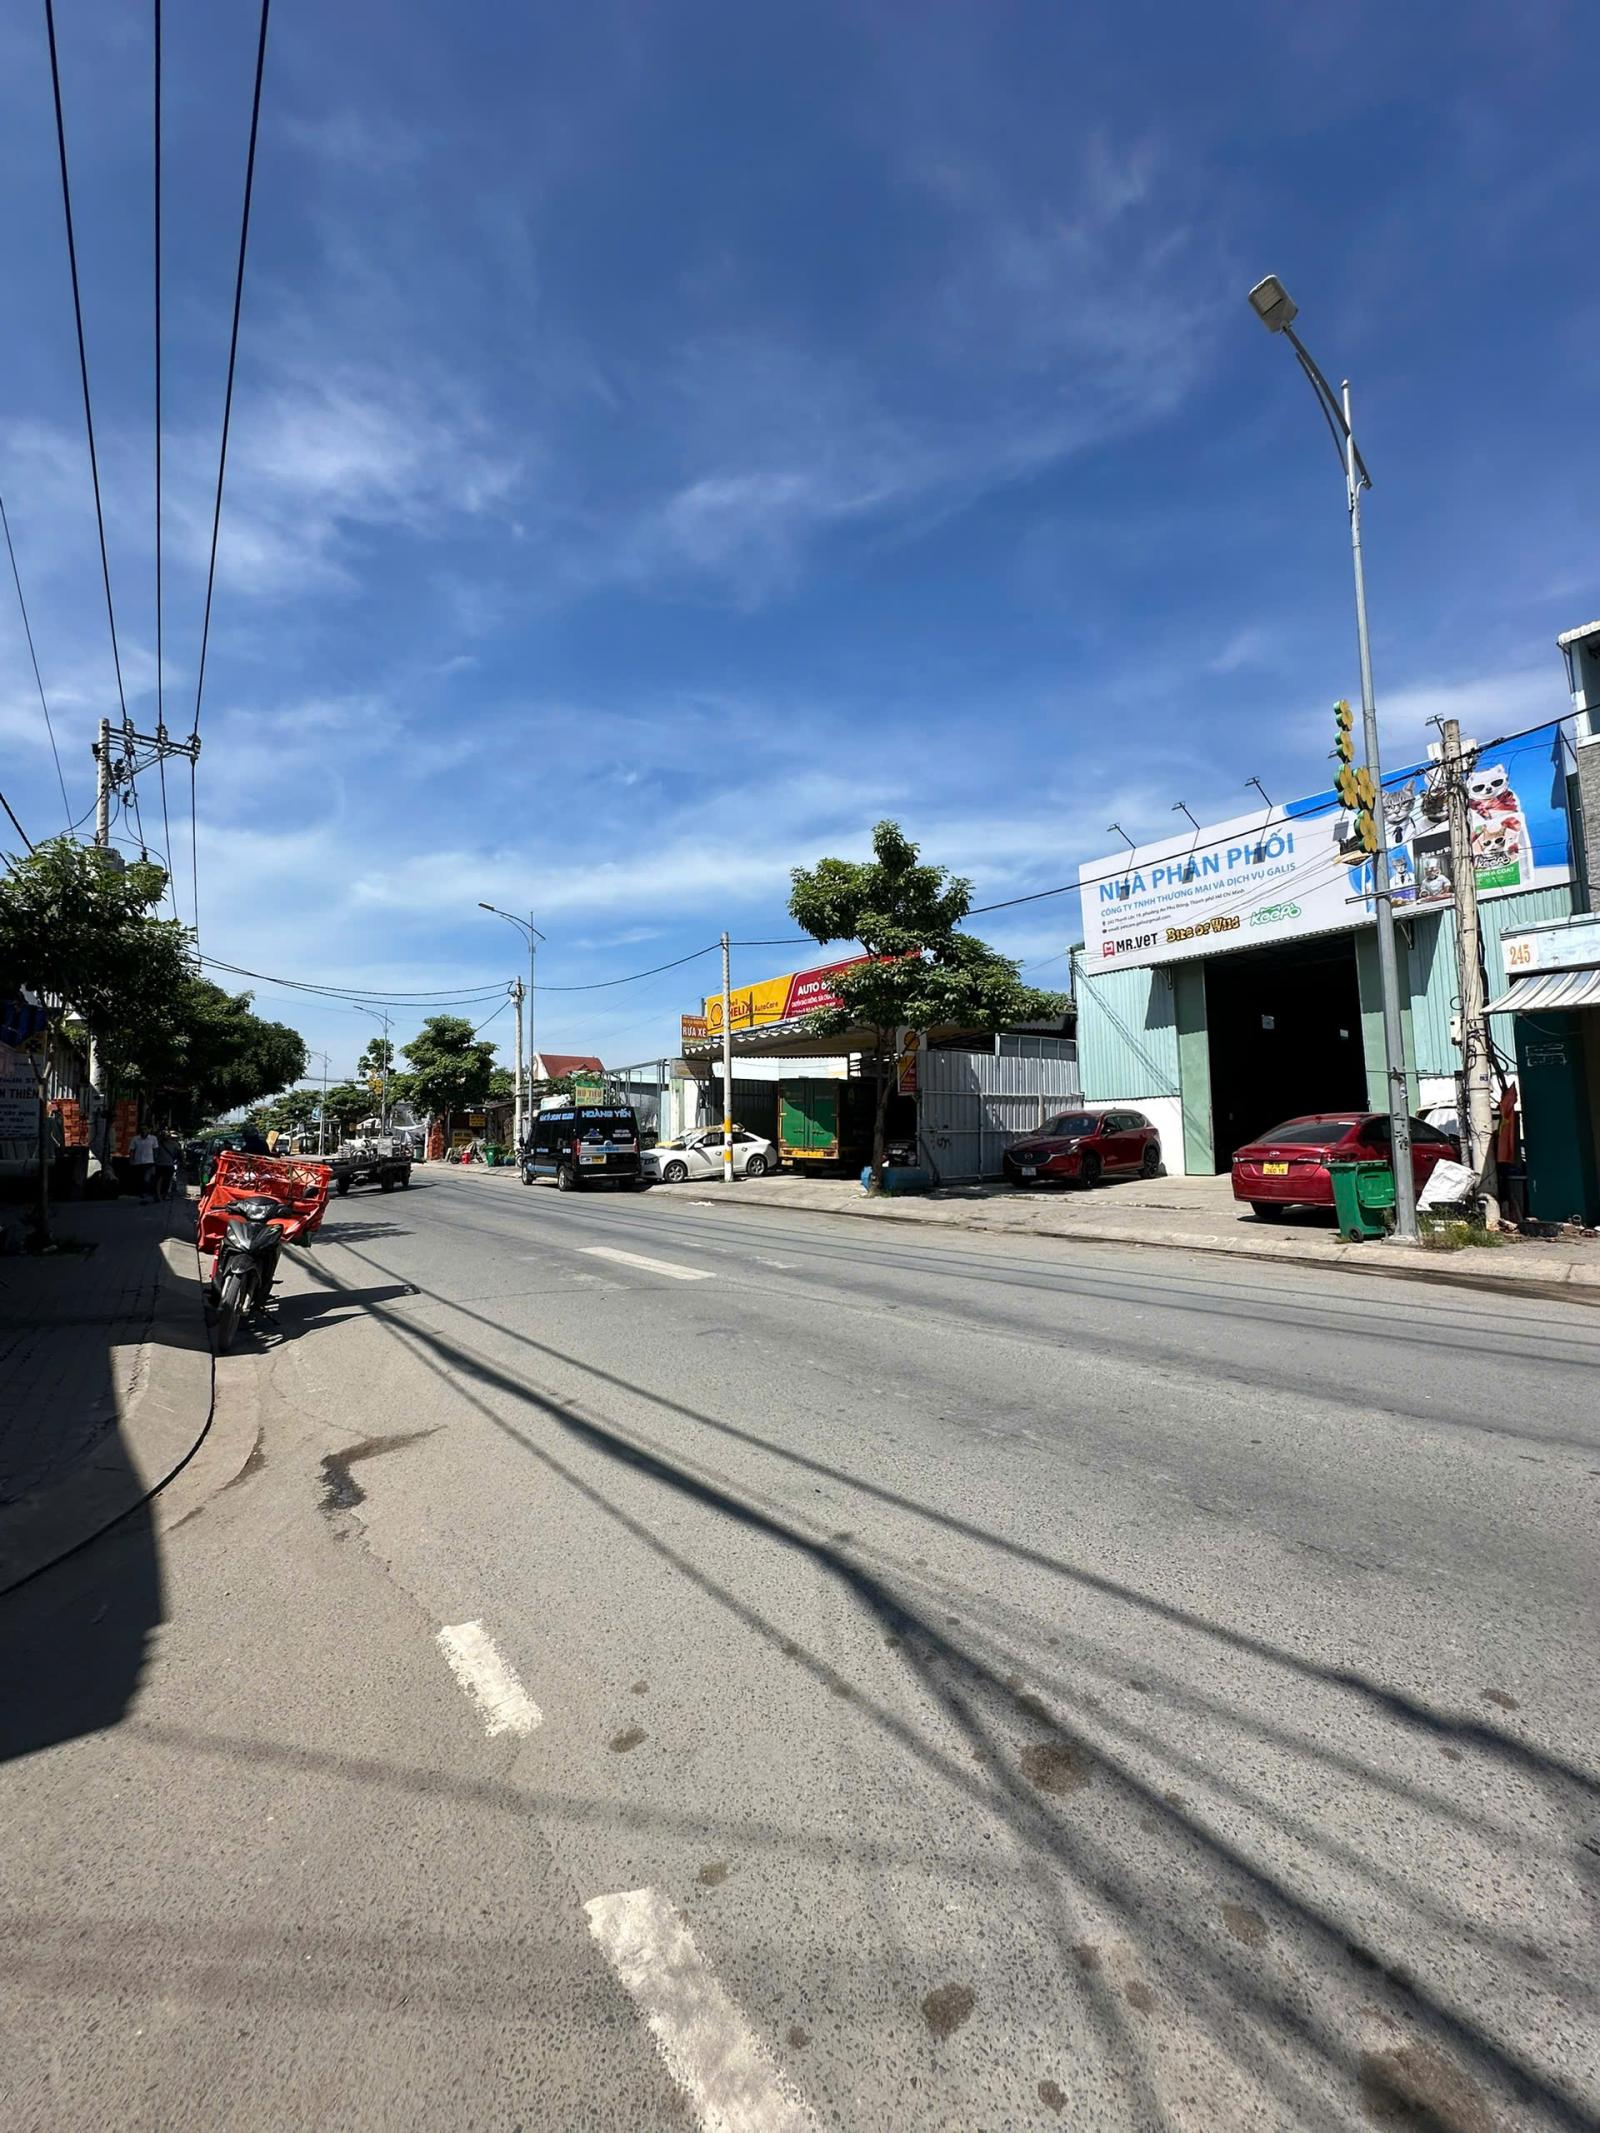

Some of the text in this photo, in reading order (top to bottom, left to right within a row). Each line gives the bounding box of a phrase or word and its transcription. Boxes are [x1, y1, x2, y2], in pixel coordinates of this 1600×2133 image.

[1133, 897, 1156, 909] TNHH
[1267, 863, 1296, 876] GALIS
[1509, 944, 1531, 965] 245
[798, 982, 820, 996] AUTO
[697, 1027, 707, 1038] XE
[581, 1108, 614, 1118] HOÀNG
